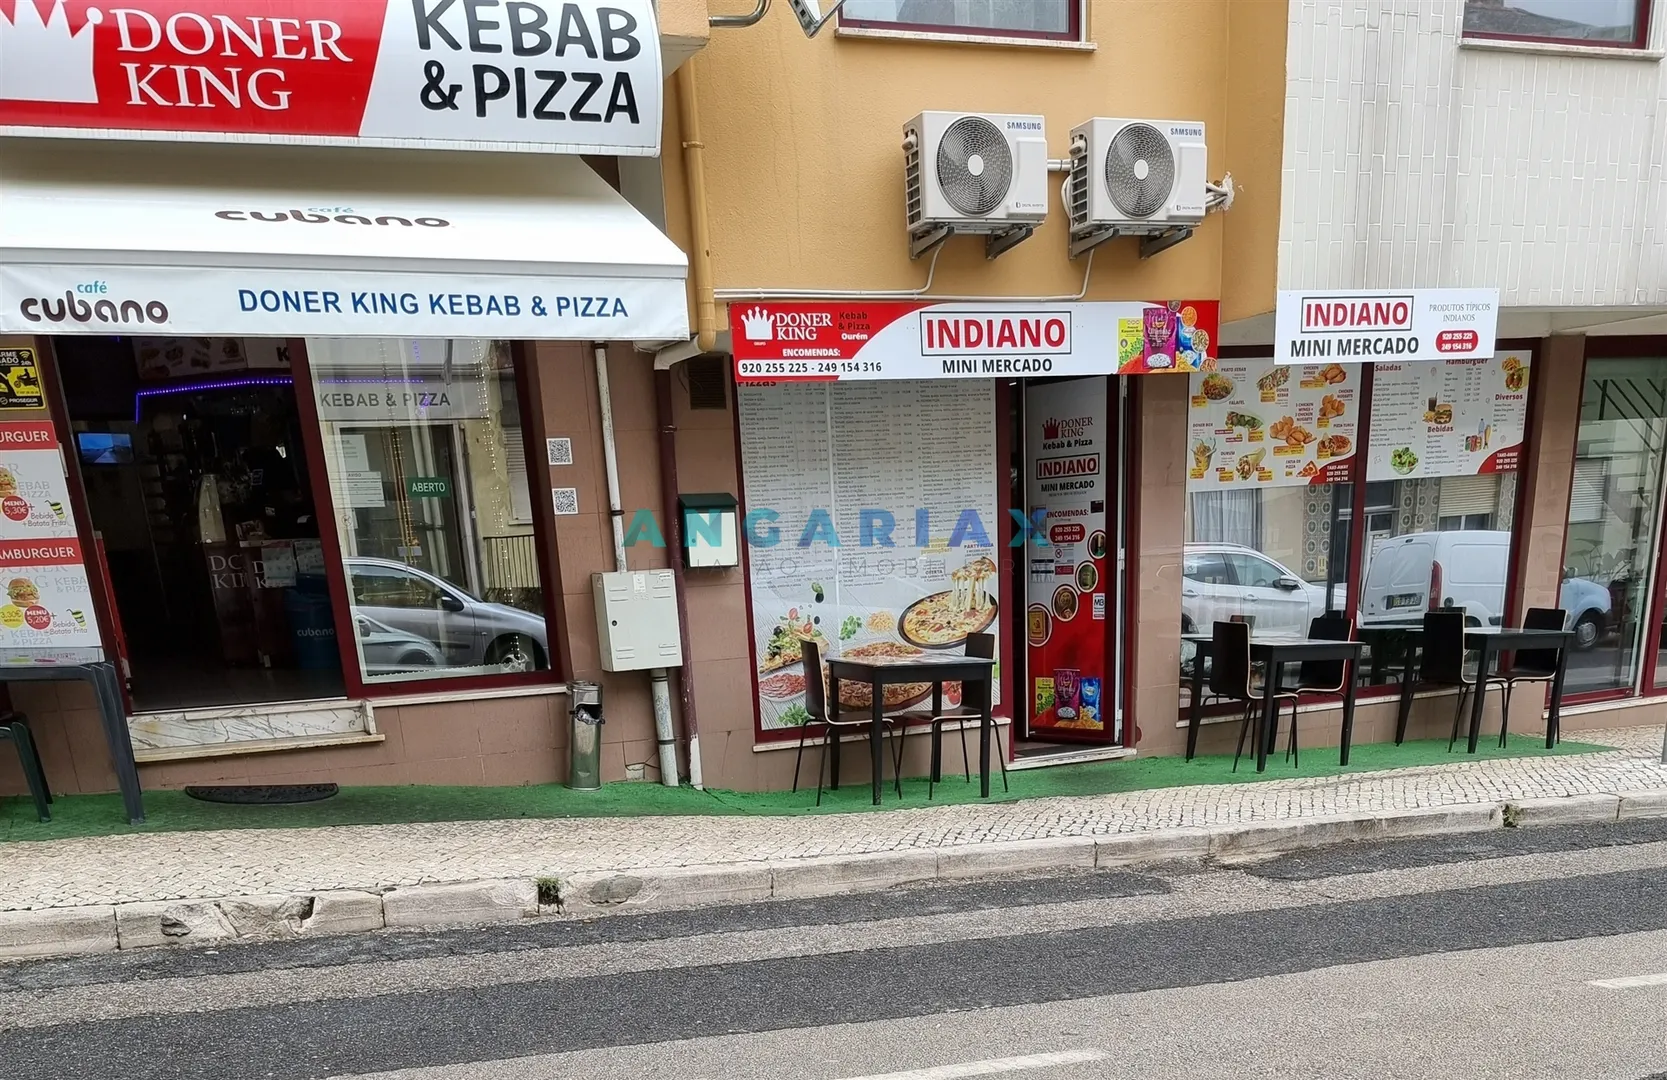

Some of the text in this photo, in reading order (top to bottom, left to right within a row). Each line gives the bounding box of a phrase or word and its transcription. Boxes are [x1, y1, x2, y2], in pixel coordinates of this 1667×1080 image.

[117, 7, 353, 63] DONER
[414, 0, 641, 62] KEBAB
[119, 61, 292, 111] KING
[420, 59, 640, 125] & PIZZA
[1006, 121, 1042, 131] SAMSUNG
[1170, 127, 1203, 137] SAMSUNG
[308, 206, 354, 214] café
[215, 209, 451, 228] cubano
[76, 280, 108, 295] café
[20, 290, 169, 325] cubano
[238, 289, 629, 318] DONER KING KEBAB & PIZZA
[1429, 301, 1491, 312] PRODUTOS TÍPICOS
[775, 312, 833, 327] DONER
[839, 311, 868, 321] Kebab
[1305, 301, 1409, 327] INDIANO
[1442, 313, 1476, 322] INDIANOS
[838, 321, 871, 331] & Pizza
[777, 327, 818, 341] KING
[841, 332, 868, 341] Ourém
[926, 318, 1066, 350] INDIANO
[782, 348, 841, 358] ENCOMENDAS:
[1290, 337, 1419, 358] MINI MERCADO
[741, 363, 762, 373] 920
[765, 363, 785, 373] 255
[789, 362, 808, 373] 225
[818, 362, 837, 373] 249
[841, 361, 860, 372] 154
[863, 361, 882, 372] 316
[942, 358, 1053, 374] MINI MERCADO
[1375, 364, 1401, 372] Saladas
[320, 392, 450, 407] KEBAB & PIZZA
[1061, 417, 1093, 429] DONER
[1427, 425, 1454, 433] Bebidas
[1061, 428, 1084, 439] KING
[1043, 440, 1065, 450] Kebab
[1074, 438, 1093, 447] Pizza
[1039, 458, 1097, 476] INDIANO
[18, 481, 50, 490] EBAB
[412, 482, 446, 493] ABERTO
[1041, 480, 1095, 492] MINI MERCADO
[1046, 509, 1089, 518] ENCOMENDAS:
[297, 626, 335, 637] cubano
